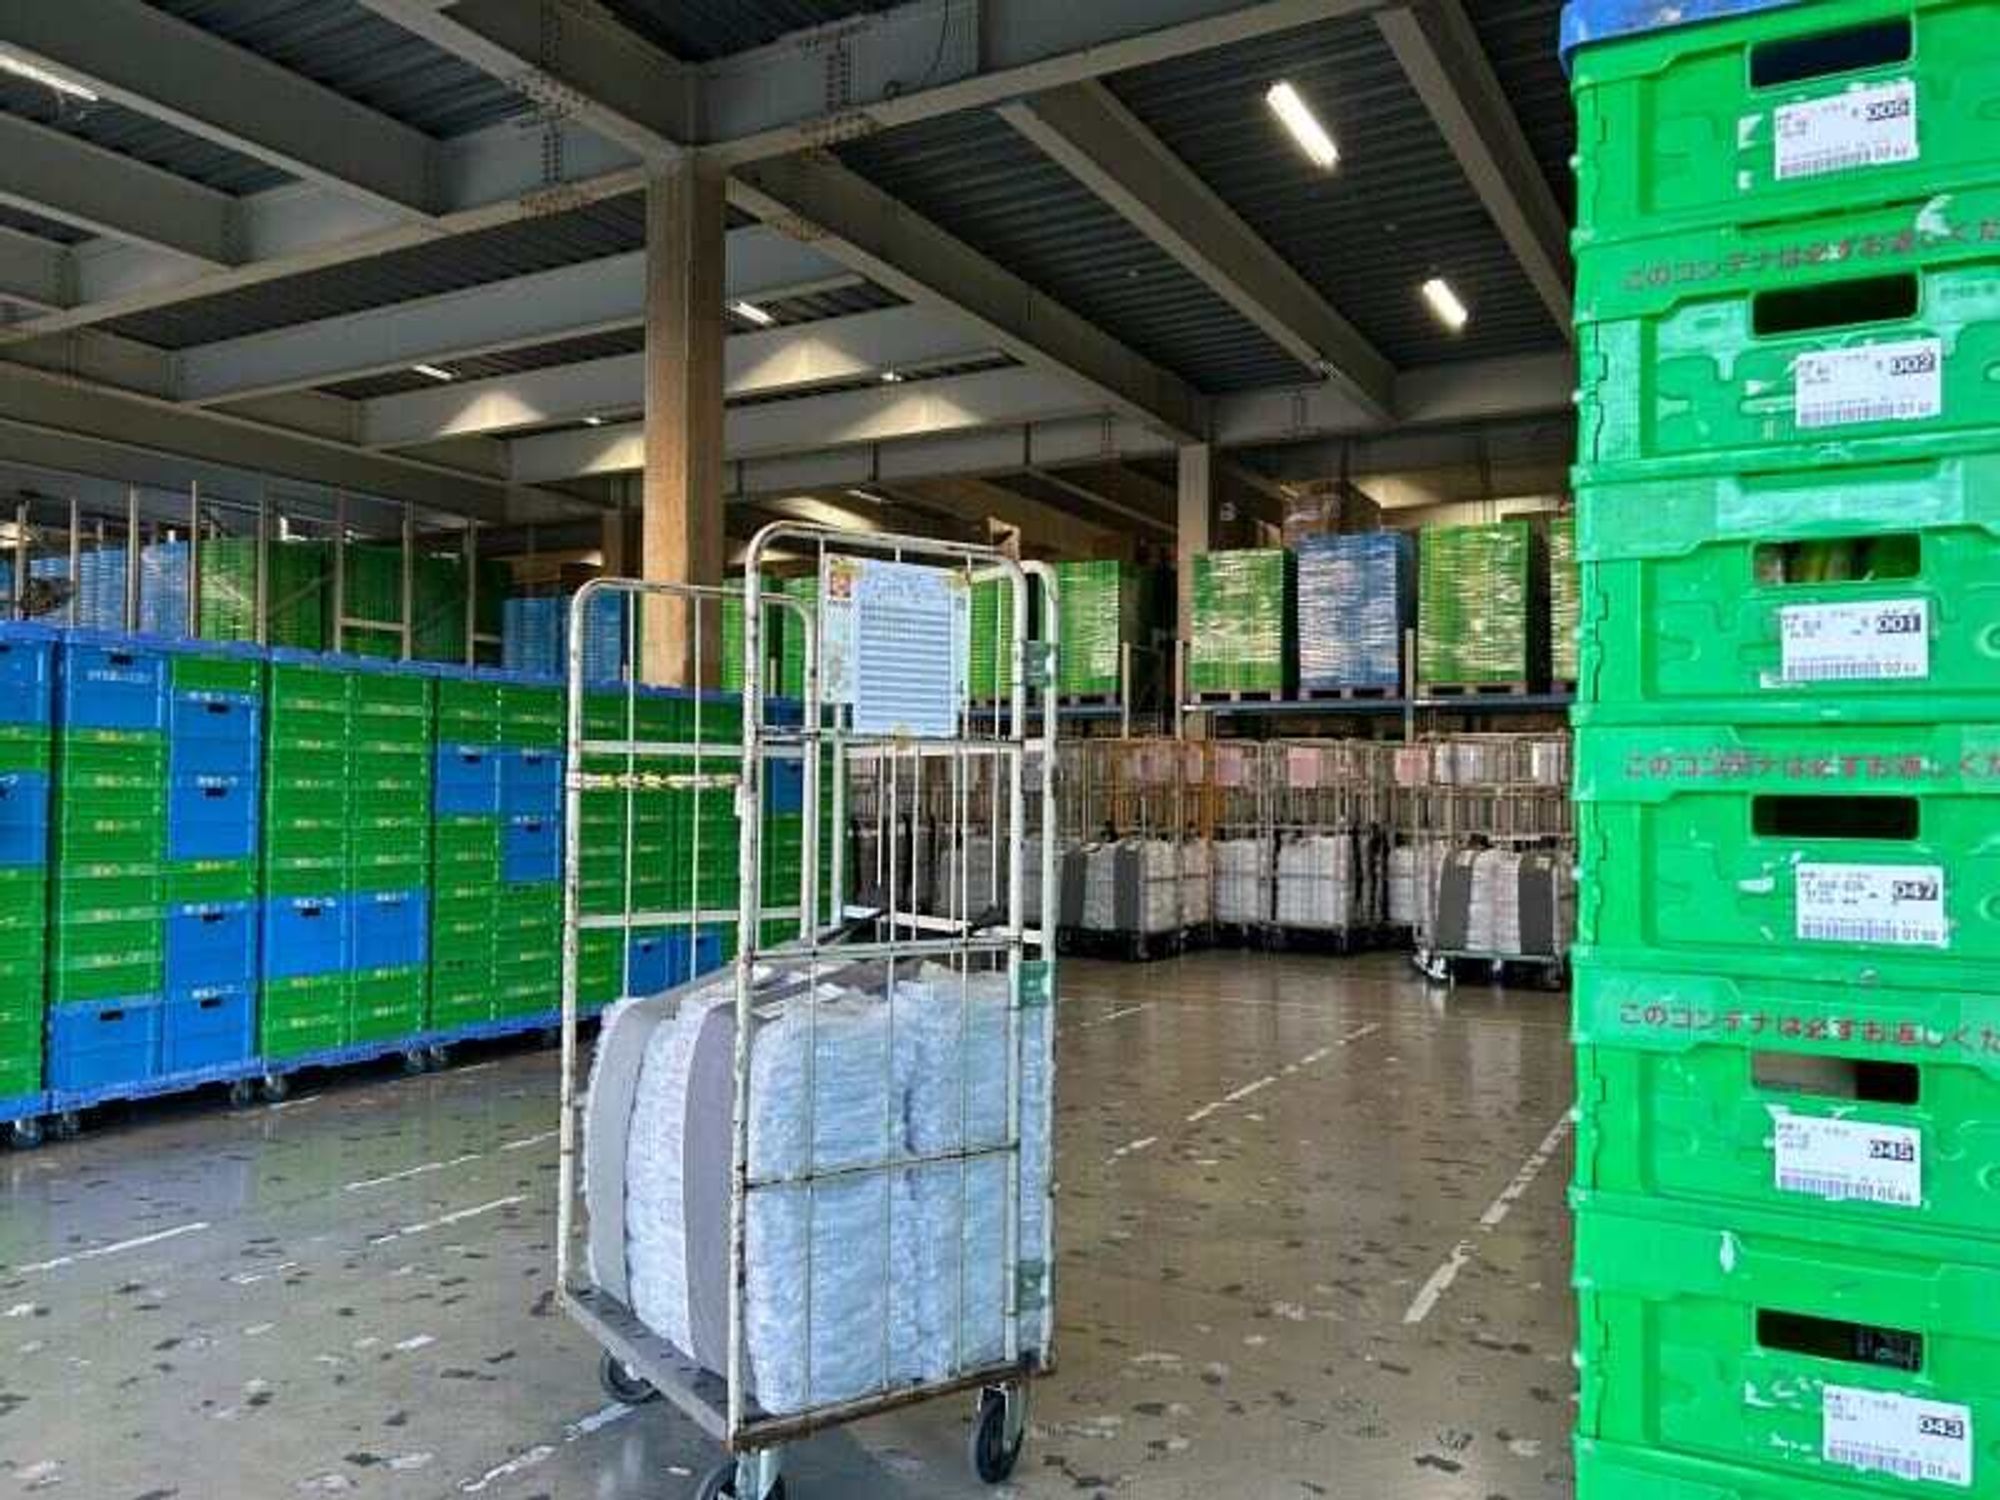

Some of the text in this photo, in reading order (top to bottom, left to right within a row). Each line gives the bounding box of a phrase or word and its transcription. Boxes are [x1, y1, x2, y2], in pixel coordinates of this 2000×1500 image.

[1878, 614, 1921, 633] 001
[1893, 880, 1938, 900] 047
[1920, 1414, 1964, 1440] 043
